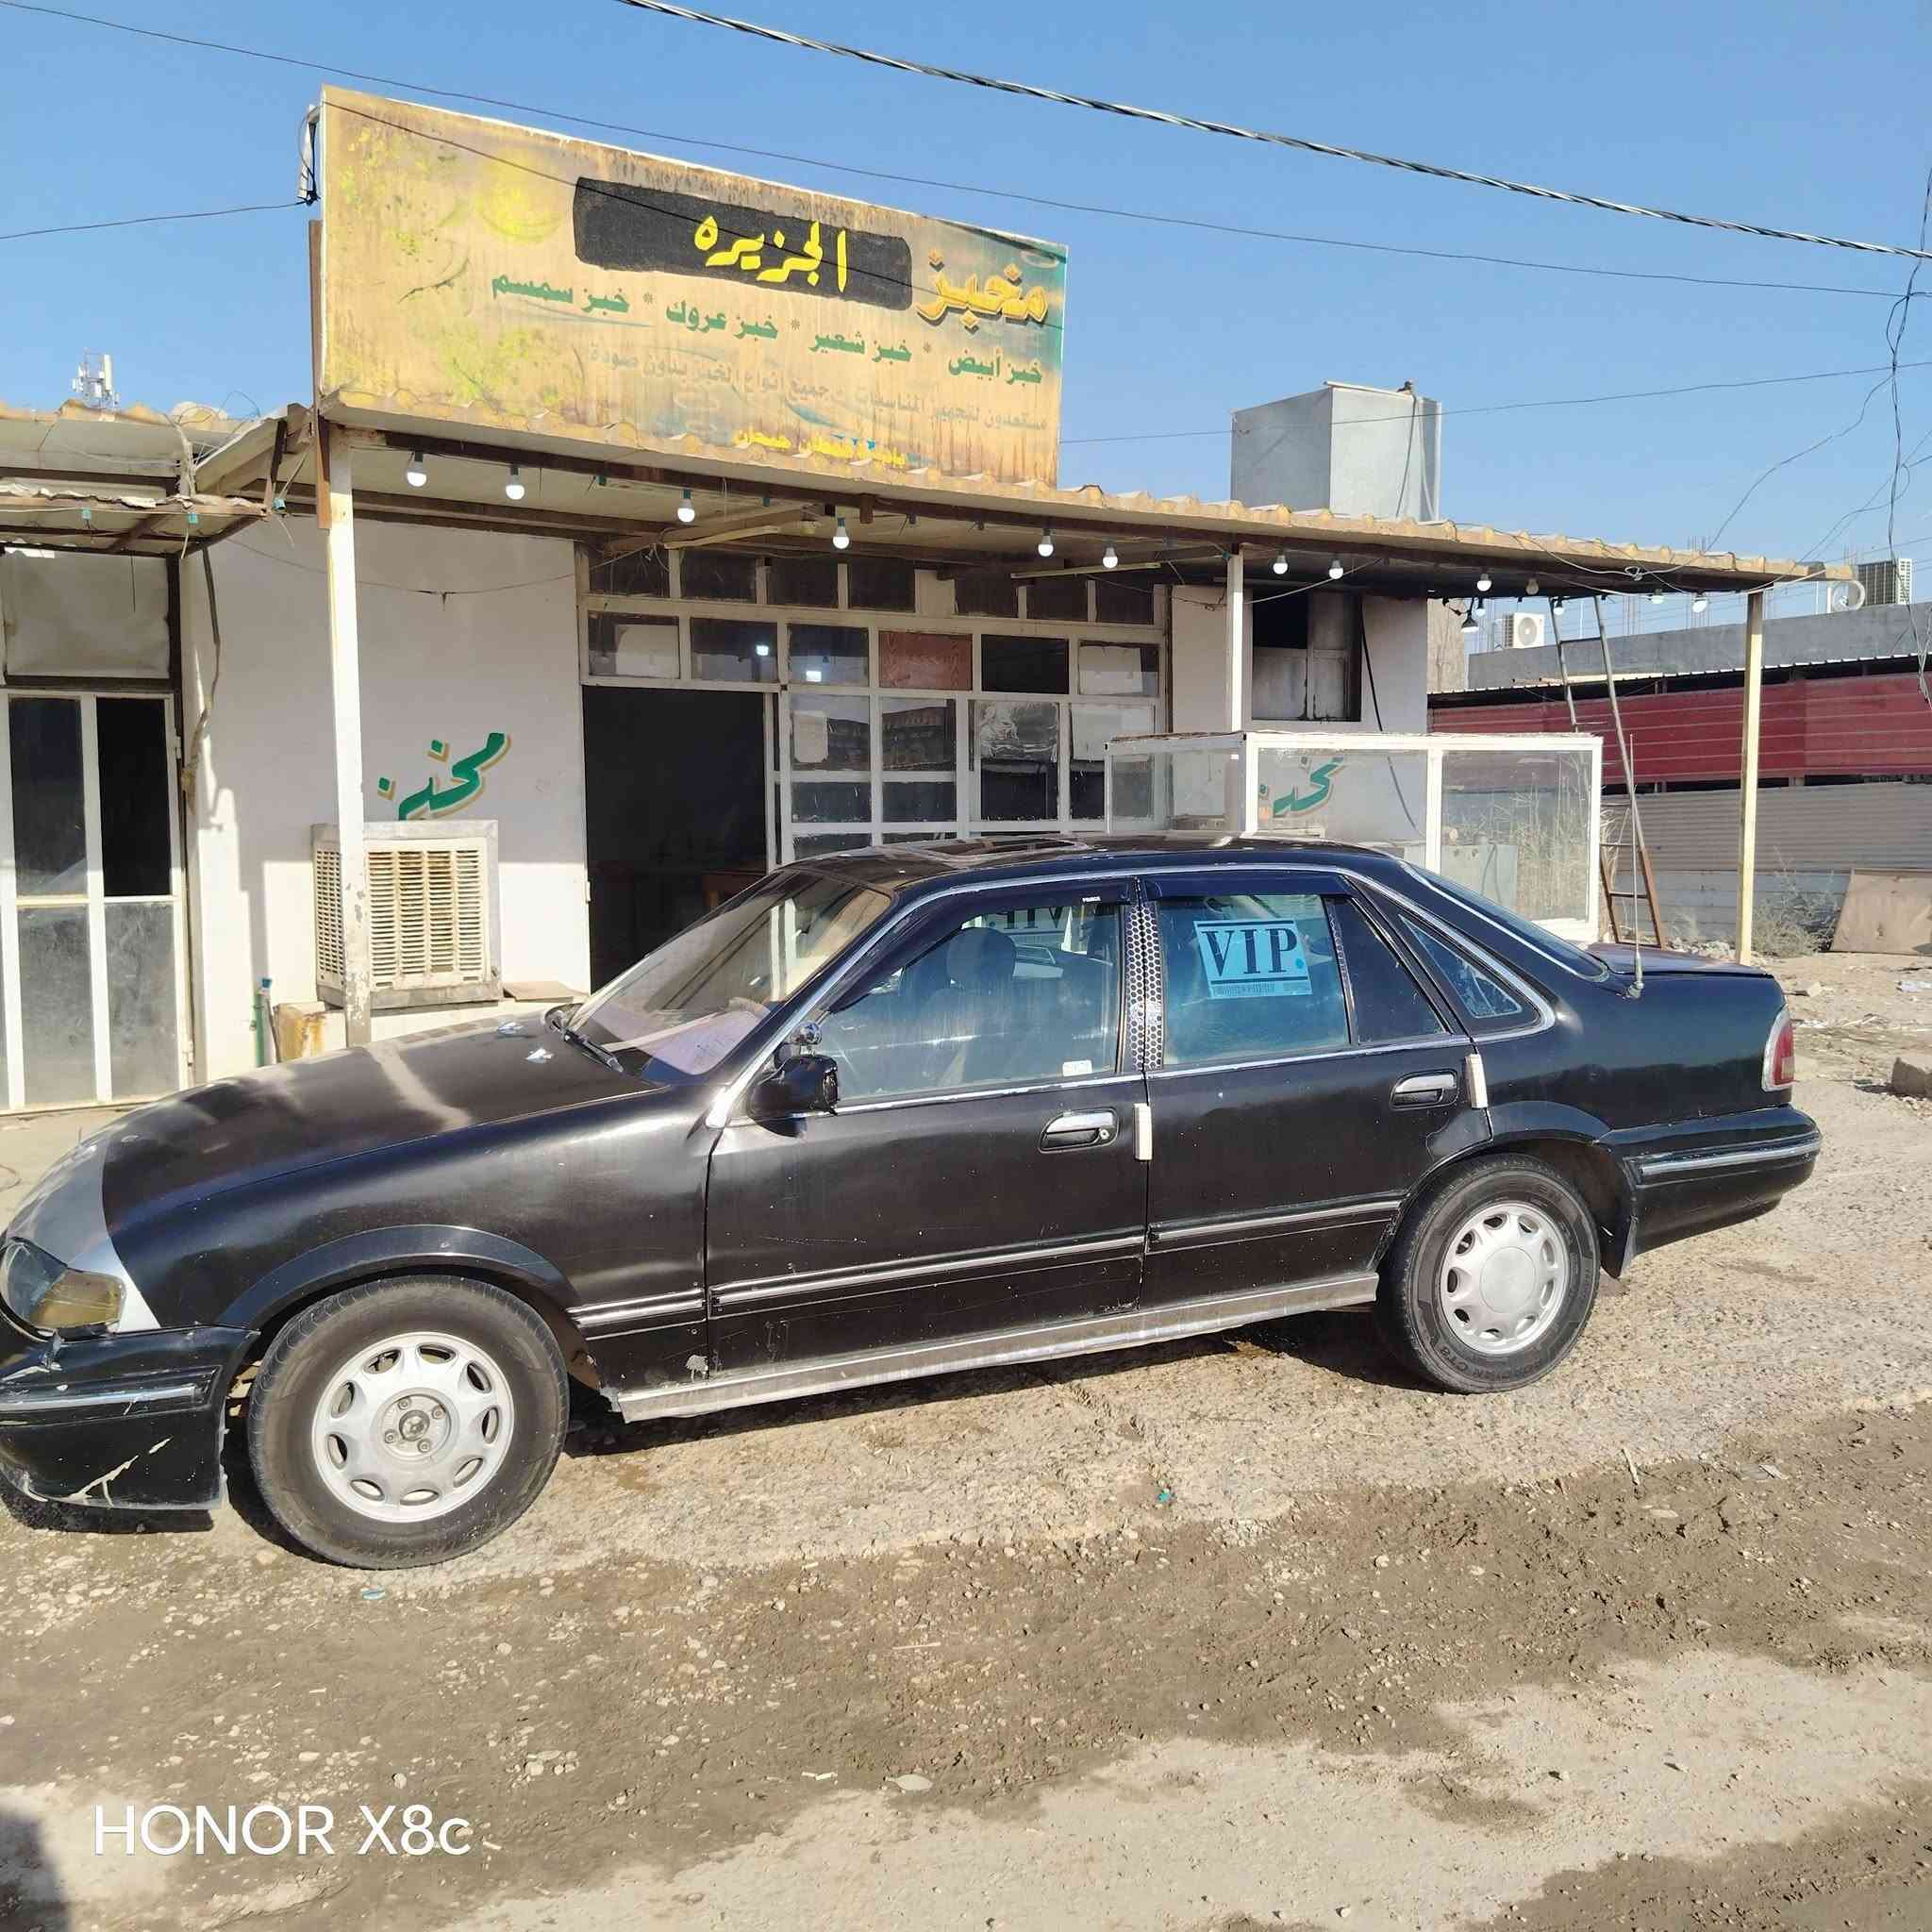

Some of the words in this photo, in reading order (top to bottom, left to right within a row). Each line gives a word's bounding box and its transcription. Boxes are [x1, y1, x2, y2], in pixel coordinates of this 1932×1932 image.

[694, 215, 847, 293] الجزيره
[492, 275, 574, 304] سمسم
[581, 288, 629, 315] خبز
[915, 248, 1049, 330] مخبز
[666, 300, 726, 333] عروك
[733, 315, 778, 341] خبز
[808, 332, 865, 355] شعير
[872, 340, 912, 365] خبز
[1006, 362, 1042, 388] خبز
[1201, 927, 1298, 977] VIP
